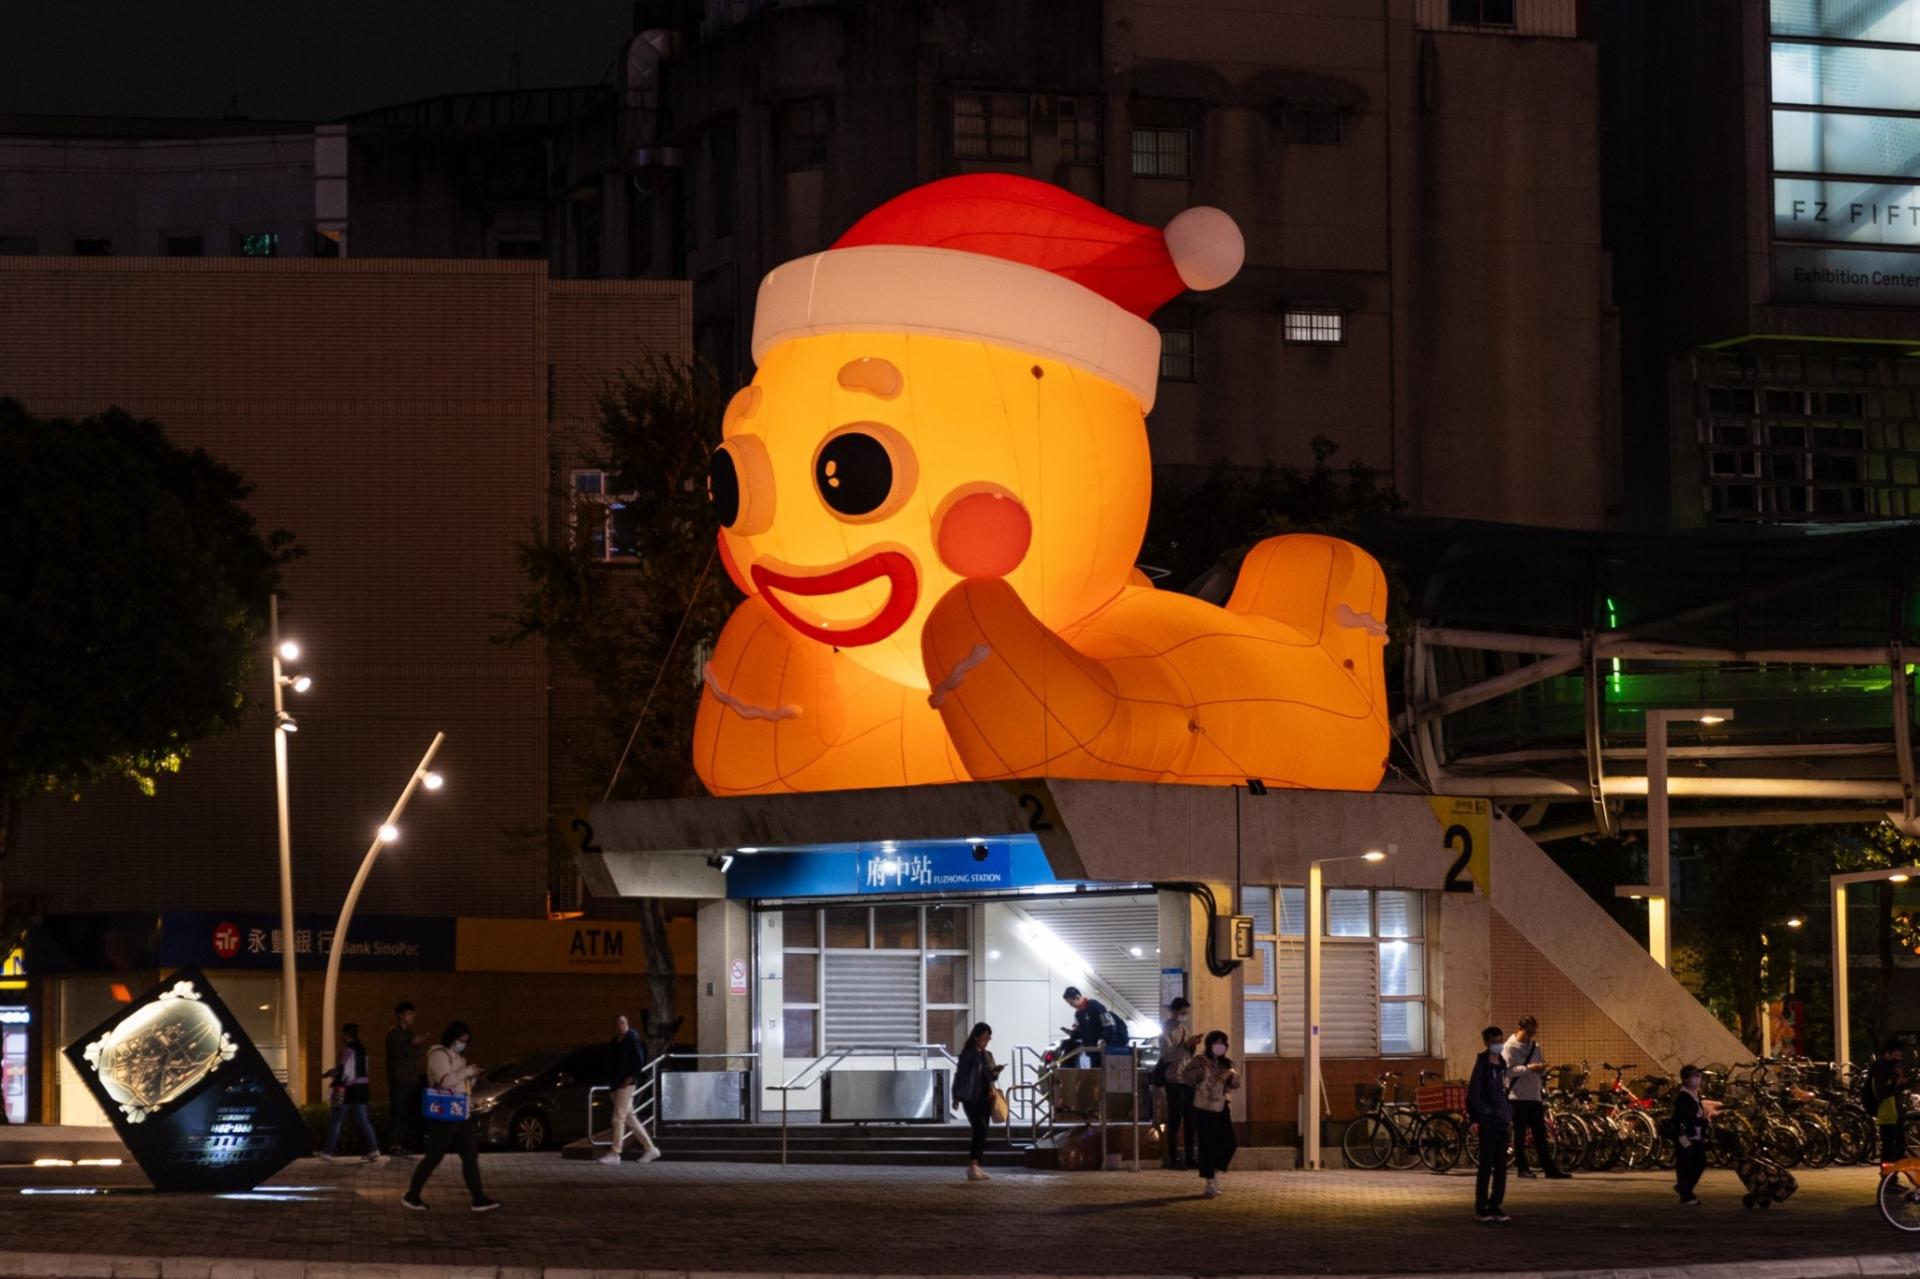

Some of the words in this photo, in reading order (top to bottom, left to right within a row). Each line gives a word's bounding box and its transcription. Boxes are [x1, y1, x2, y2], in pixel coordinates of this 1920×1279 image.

[1793, 200, 1828, 222] FZ
[1794, 267, 1868, 285] Exhibition
[1872, 271, 1920, 287] Center
[1019, 793, 1054, 831] 2
[571, 819, 602, 853] 2
[866, 855, 932, 887] 府中站
[934, 874, 970, 884] FUZHONG
[971, 873, 1001, 883] STATION
[1444, 824, 1474, 893] 2
[373, 941, 419, 957] SinoPac
[569, 929, 624, 956] ATM
